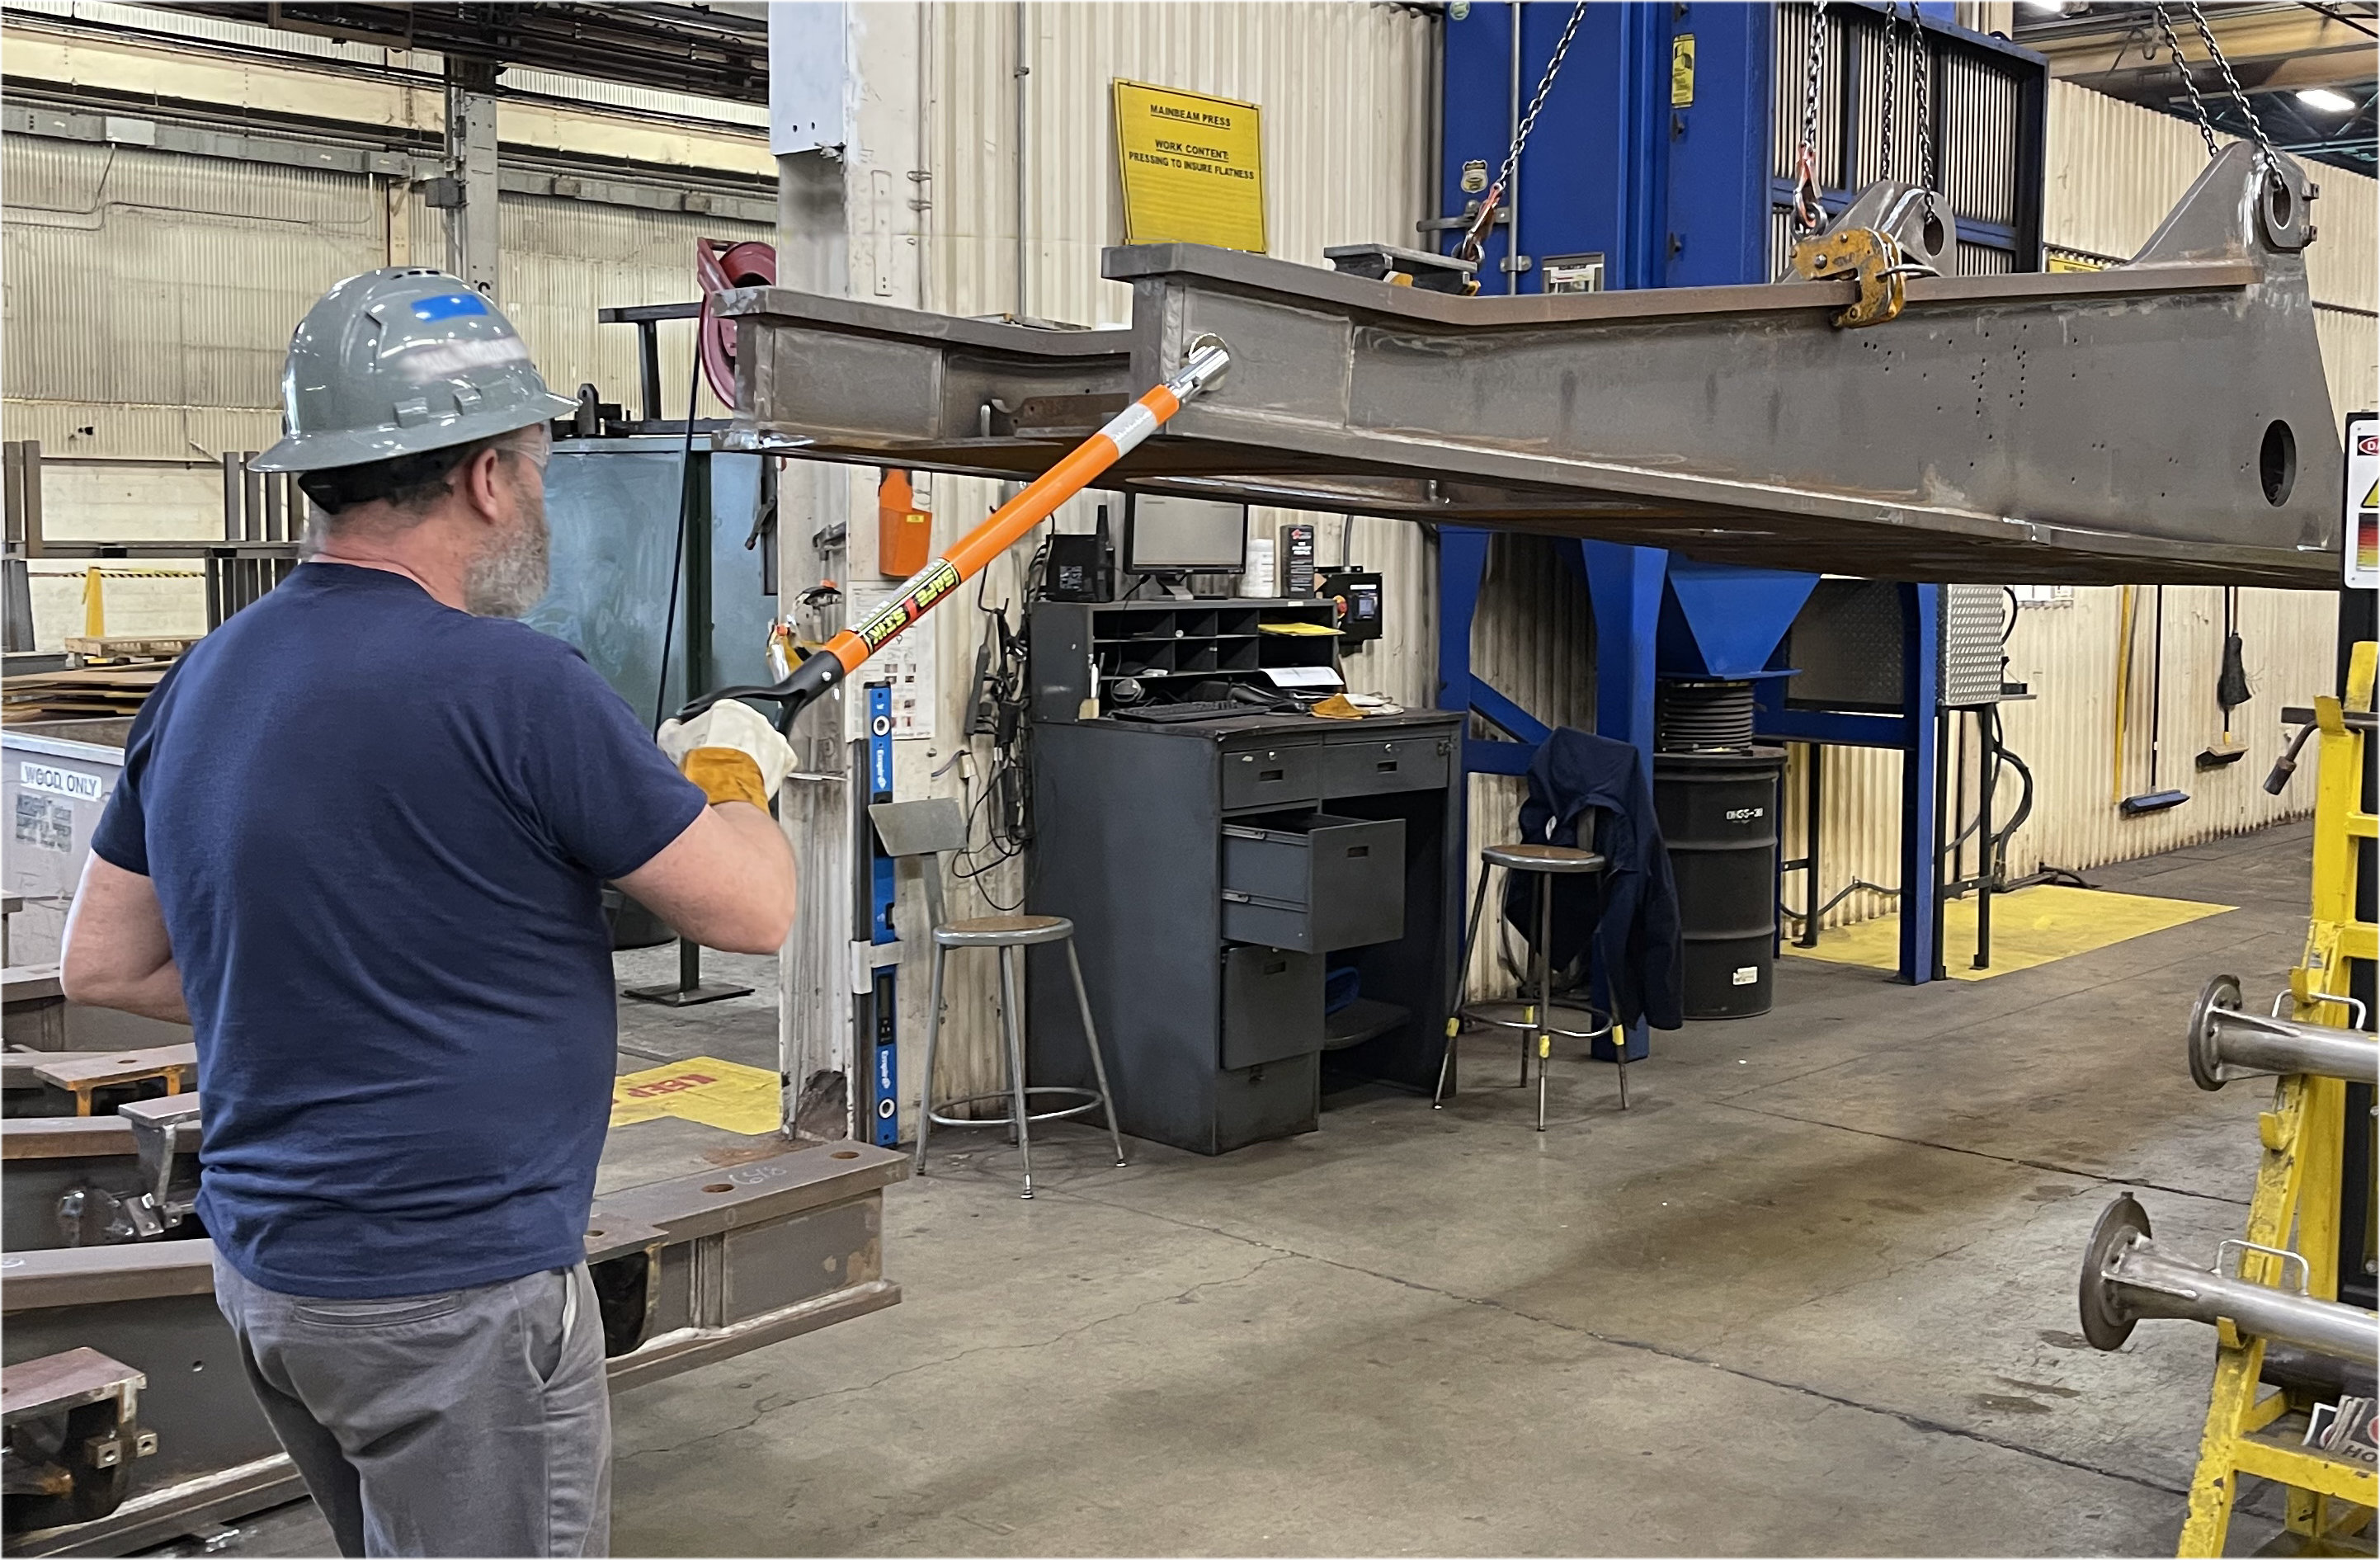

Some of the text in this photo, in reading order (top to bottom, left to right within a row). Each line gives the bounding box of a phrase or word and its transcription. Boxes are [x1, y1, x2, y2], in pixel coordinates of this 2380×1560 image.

[1150, 104, 1231, 127] MAINBEAM PRESS
[1155, 139, 1182, 152] WORK
[1129, 151, 1254, 180] PRESSING TO INSURE FLATNESS
[915, 568, 955, 608] SAFE
[24, 765, 97, 797] WOOD ONLY
